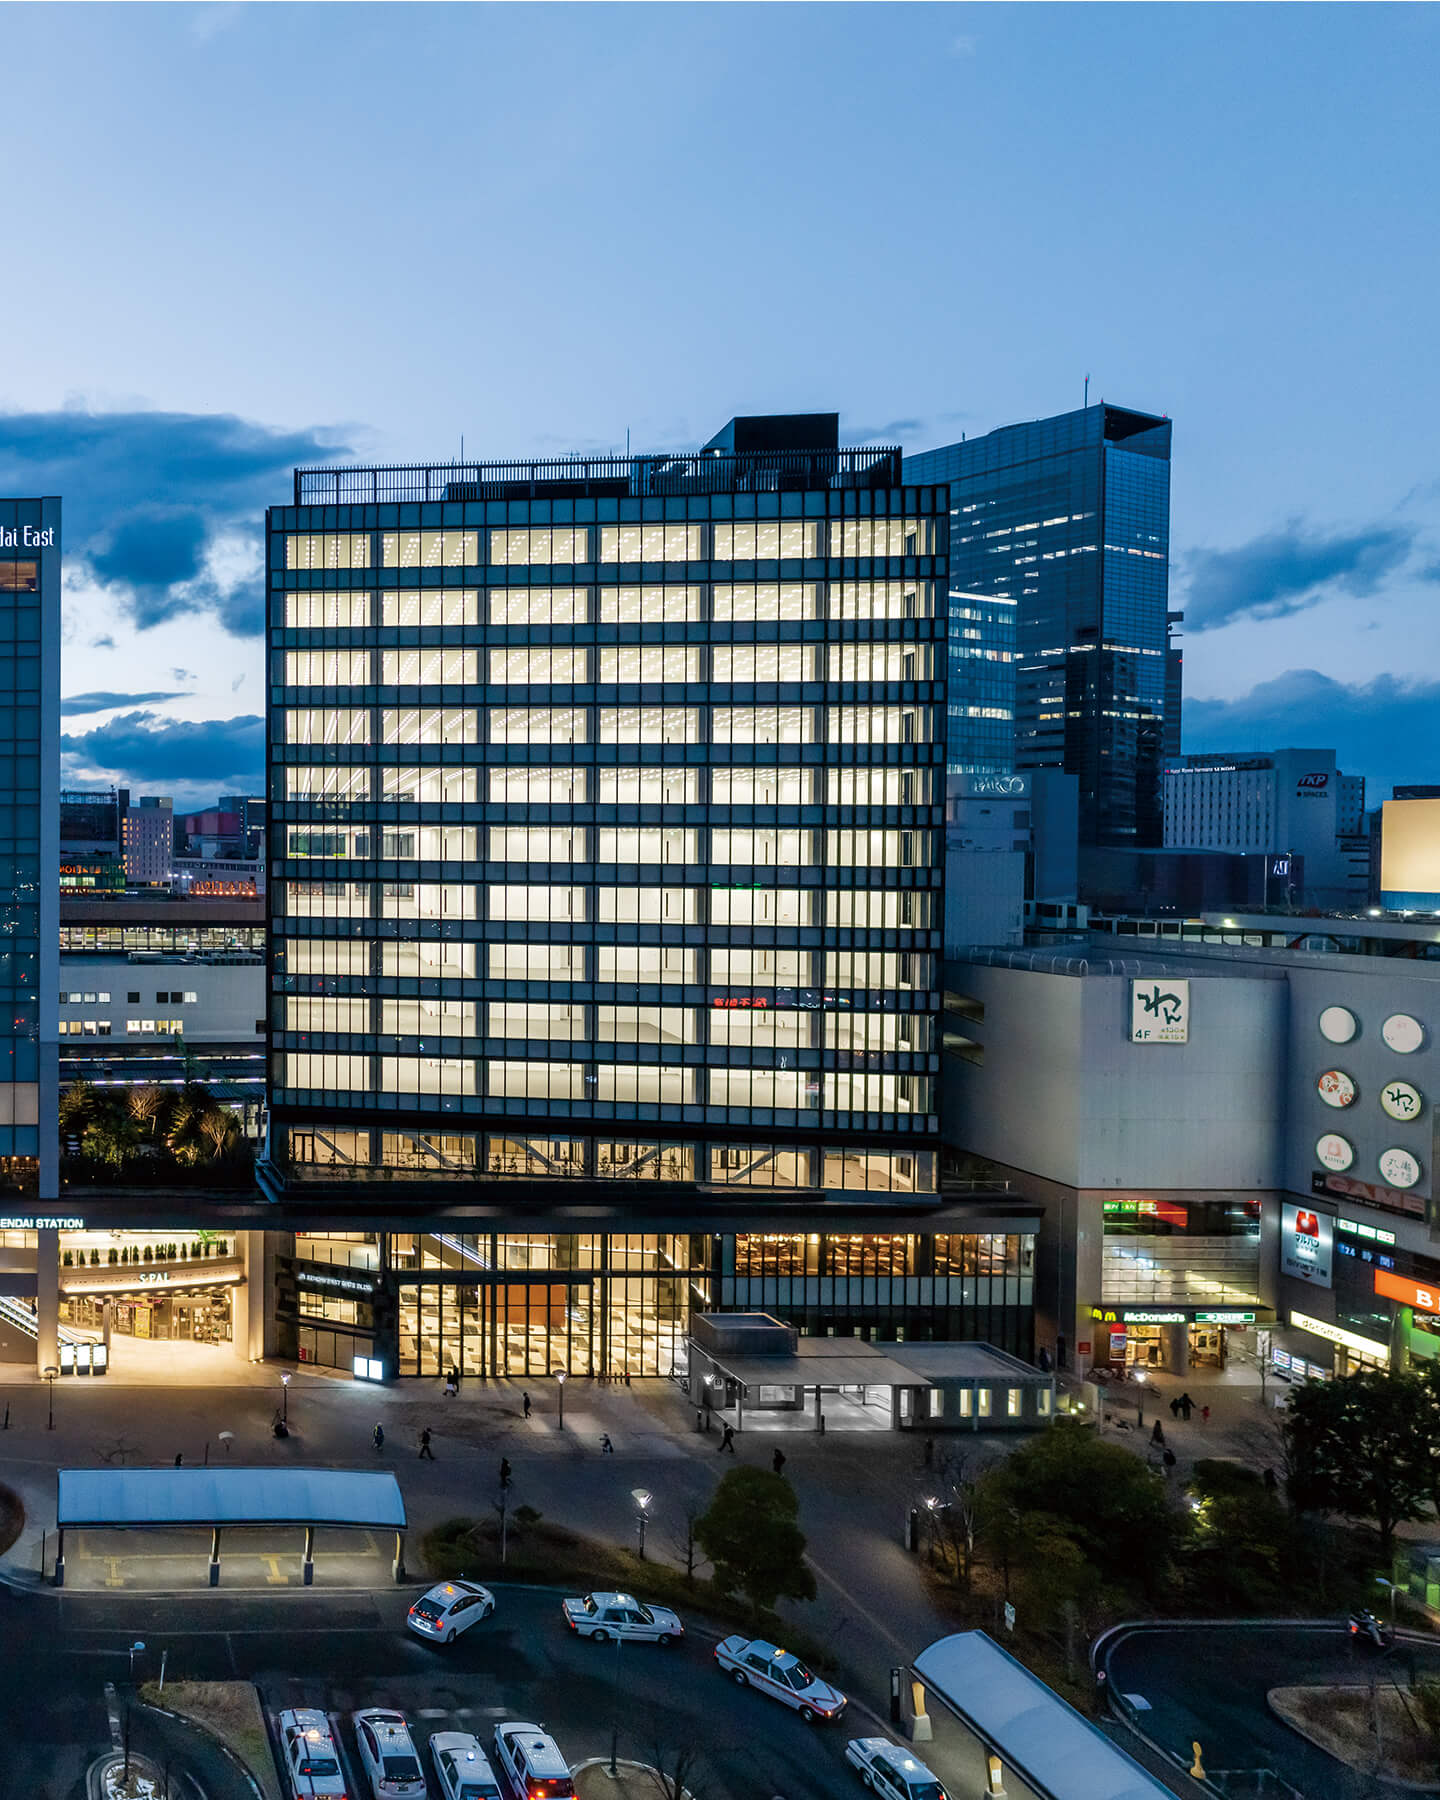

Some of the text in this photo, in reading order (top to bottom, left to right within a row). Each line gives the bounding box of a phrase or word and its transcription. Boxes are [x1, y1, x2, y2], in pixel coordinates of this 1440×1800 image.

[24, 525, 55, 547] East
[1301, 774, 1327, 786] TKP
[1135, 1029, 1152, 1039] 4F
[36, 1218, 84, 1229] STATION
[1123, 1311, 1186, 1323] McDonald's
